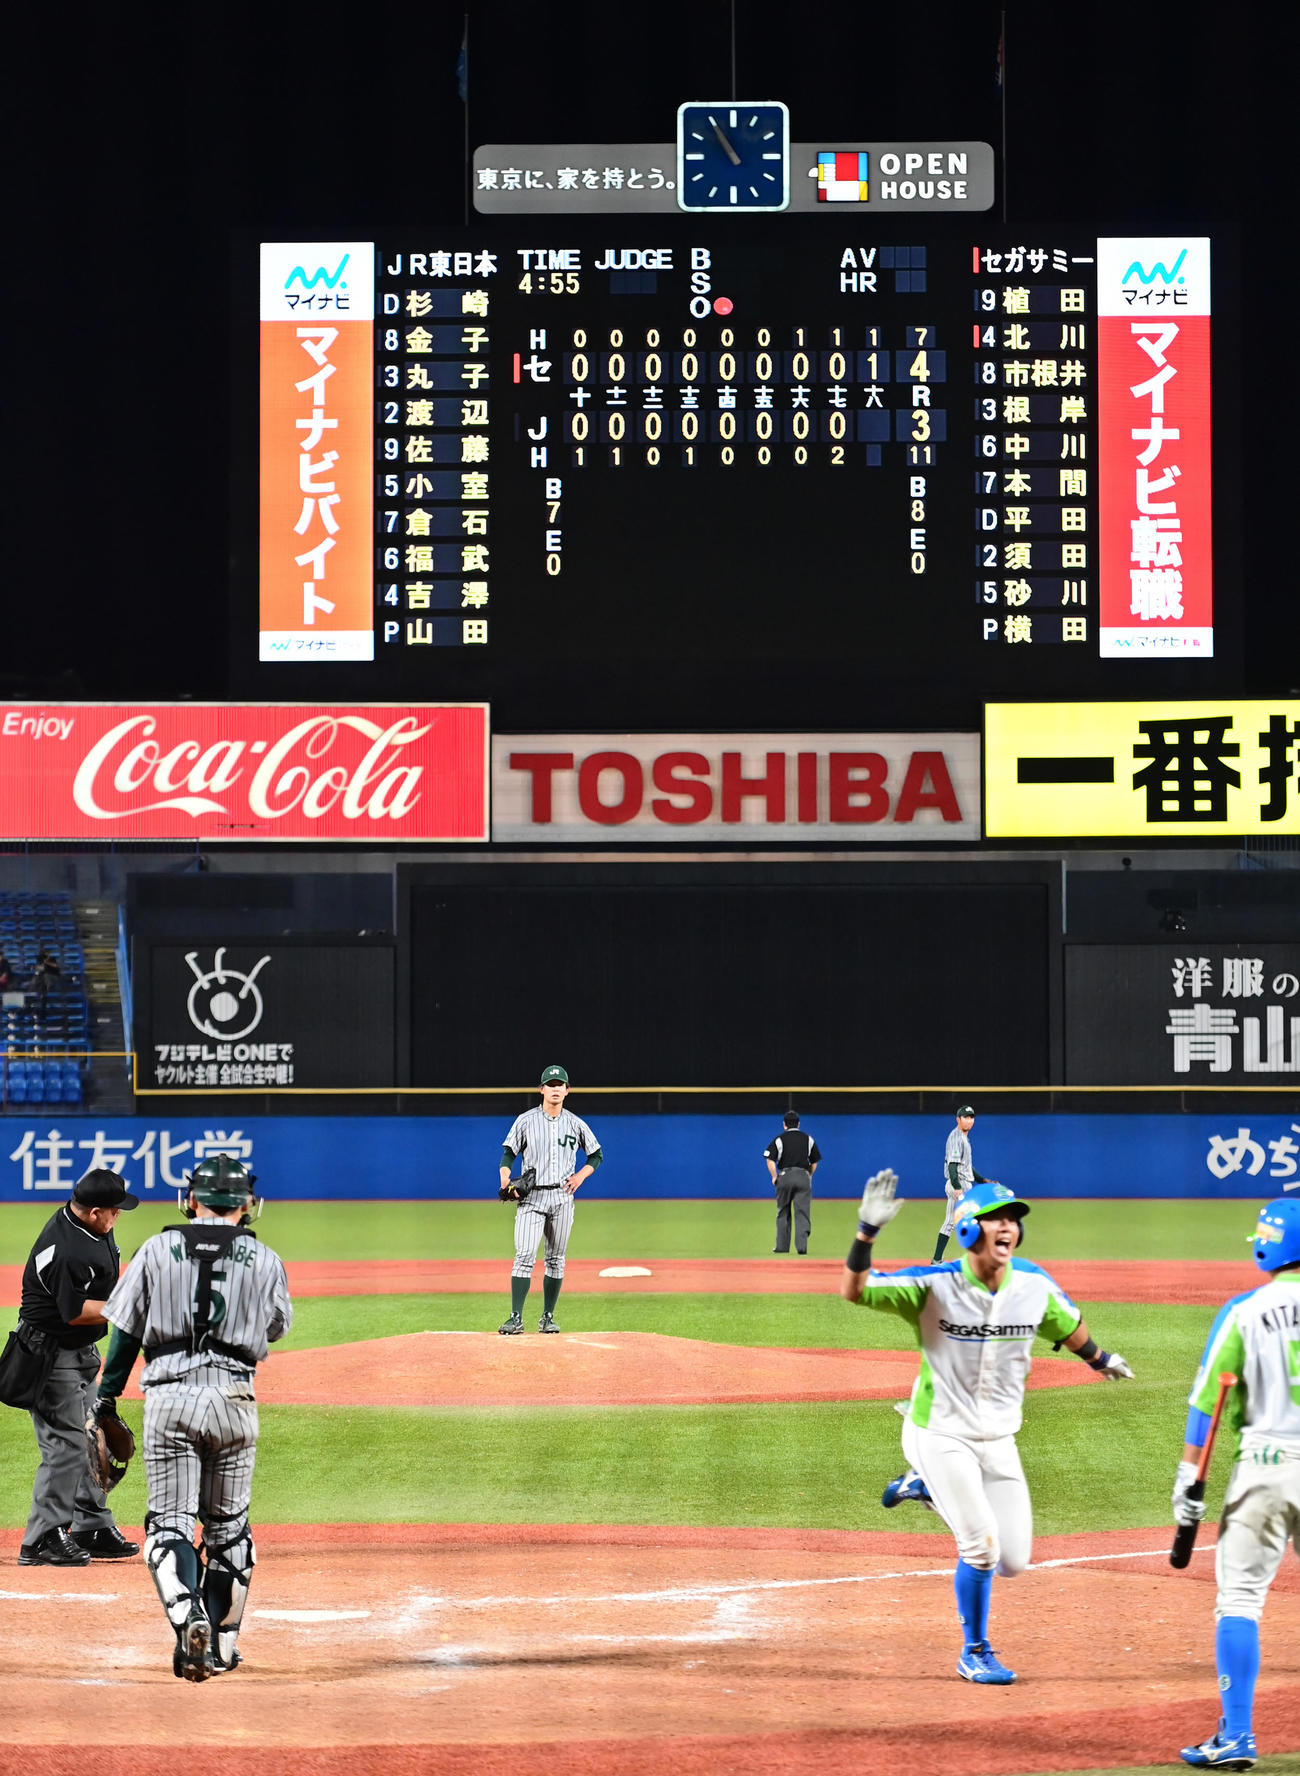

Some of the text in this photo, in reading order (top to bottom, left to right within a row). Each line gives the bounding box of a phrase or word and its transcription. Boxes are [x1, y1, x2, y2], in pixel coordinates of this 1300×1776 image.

[881, 153, 966, 175] OPEN
[478, 167, 675, 190] 東京に、家を持とう。
[882, 181, 966, 199] HOUSE
[517, 249, 673, 270] TIME JUDGE
[692, 248, 711, 269] B
[841, 248, 876, 268] AV
[981, 246, 1093, 273] セガサミー
[519, 273, 579, 294] 4:55
[691, 272, 711, 294] S
[841, 272, 876, 292] HR
[285, 295, 349, 309] マイナビ
[384, 294, 399, 314] D
[982, 289, 995, 311] 9
[1122, 289, 1187, 305] マイナビ
[385, 329, 398, 350] 8
[530, 328, 927, 349] H 0 0 0 0 0 0 1 1 1 7
[982, 326, 995, 347] 4
[385, 366, 398, 387] 3
[523, 351, 930, 382] セ 0 0 0 0 0 0 0 0 1 4
[983, 362, 996, 384] 8
[913, 385, 930, 406] R
[385, 402, 398, 423] 2
[983, 399, 996, 420] 3
[528, 410, 930, 441] J 0 0 0 0 0 0 0 0 3
[385, 438, 398, 460] 9
[531, 446, 930, 467] H 1 1 0 1 0 0 0 2 11
[983, 435, 996, 457] 6
[294, 327, 341, 625] マイナビバイト
[1129, 322, 1184, 620] マイナビ転職
[385, 475, 398, 496] 5
[983, 472, 996, 493] 7
[385, 511, 398, 532] 7
[546, 478, 561, 575] B 7 E 0
[911, 477, 926, 573] B 8 E 0
[982, 509, 997, 530] D
[385, 548, 398, 569] 6
[984, 545, 997, 566] 2
[385, 584, 398, 606] 4
[984, 581, 997, 603] 5
[385, 621, 399, 642] P
[984, 619, 998, 640] P
[2, 712, 74, 740] Enjoy
[72, 714, 437, 819] Coca-Cola
[509, 751, 963, 823] TOSHIBA
[1171, 957, 1300, 998] 洋服の
[1165, 1003, 1300, 1073] 青山
[558, 1135, 577, 1150] JR
